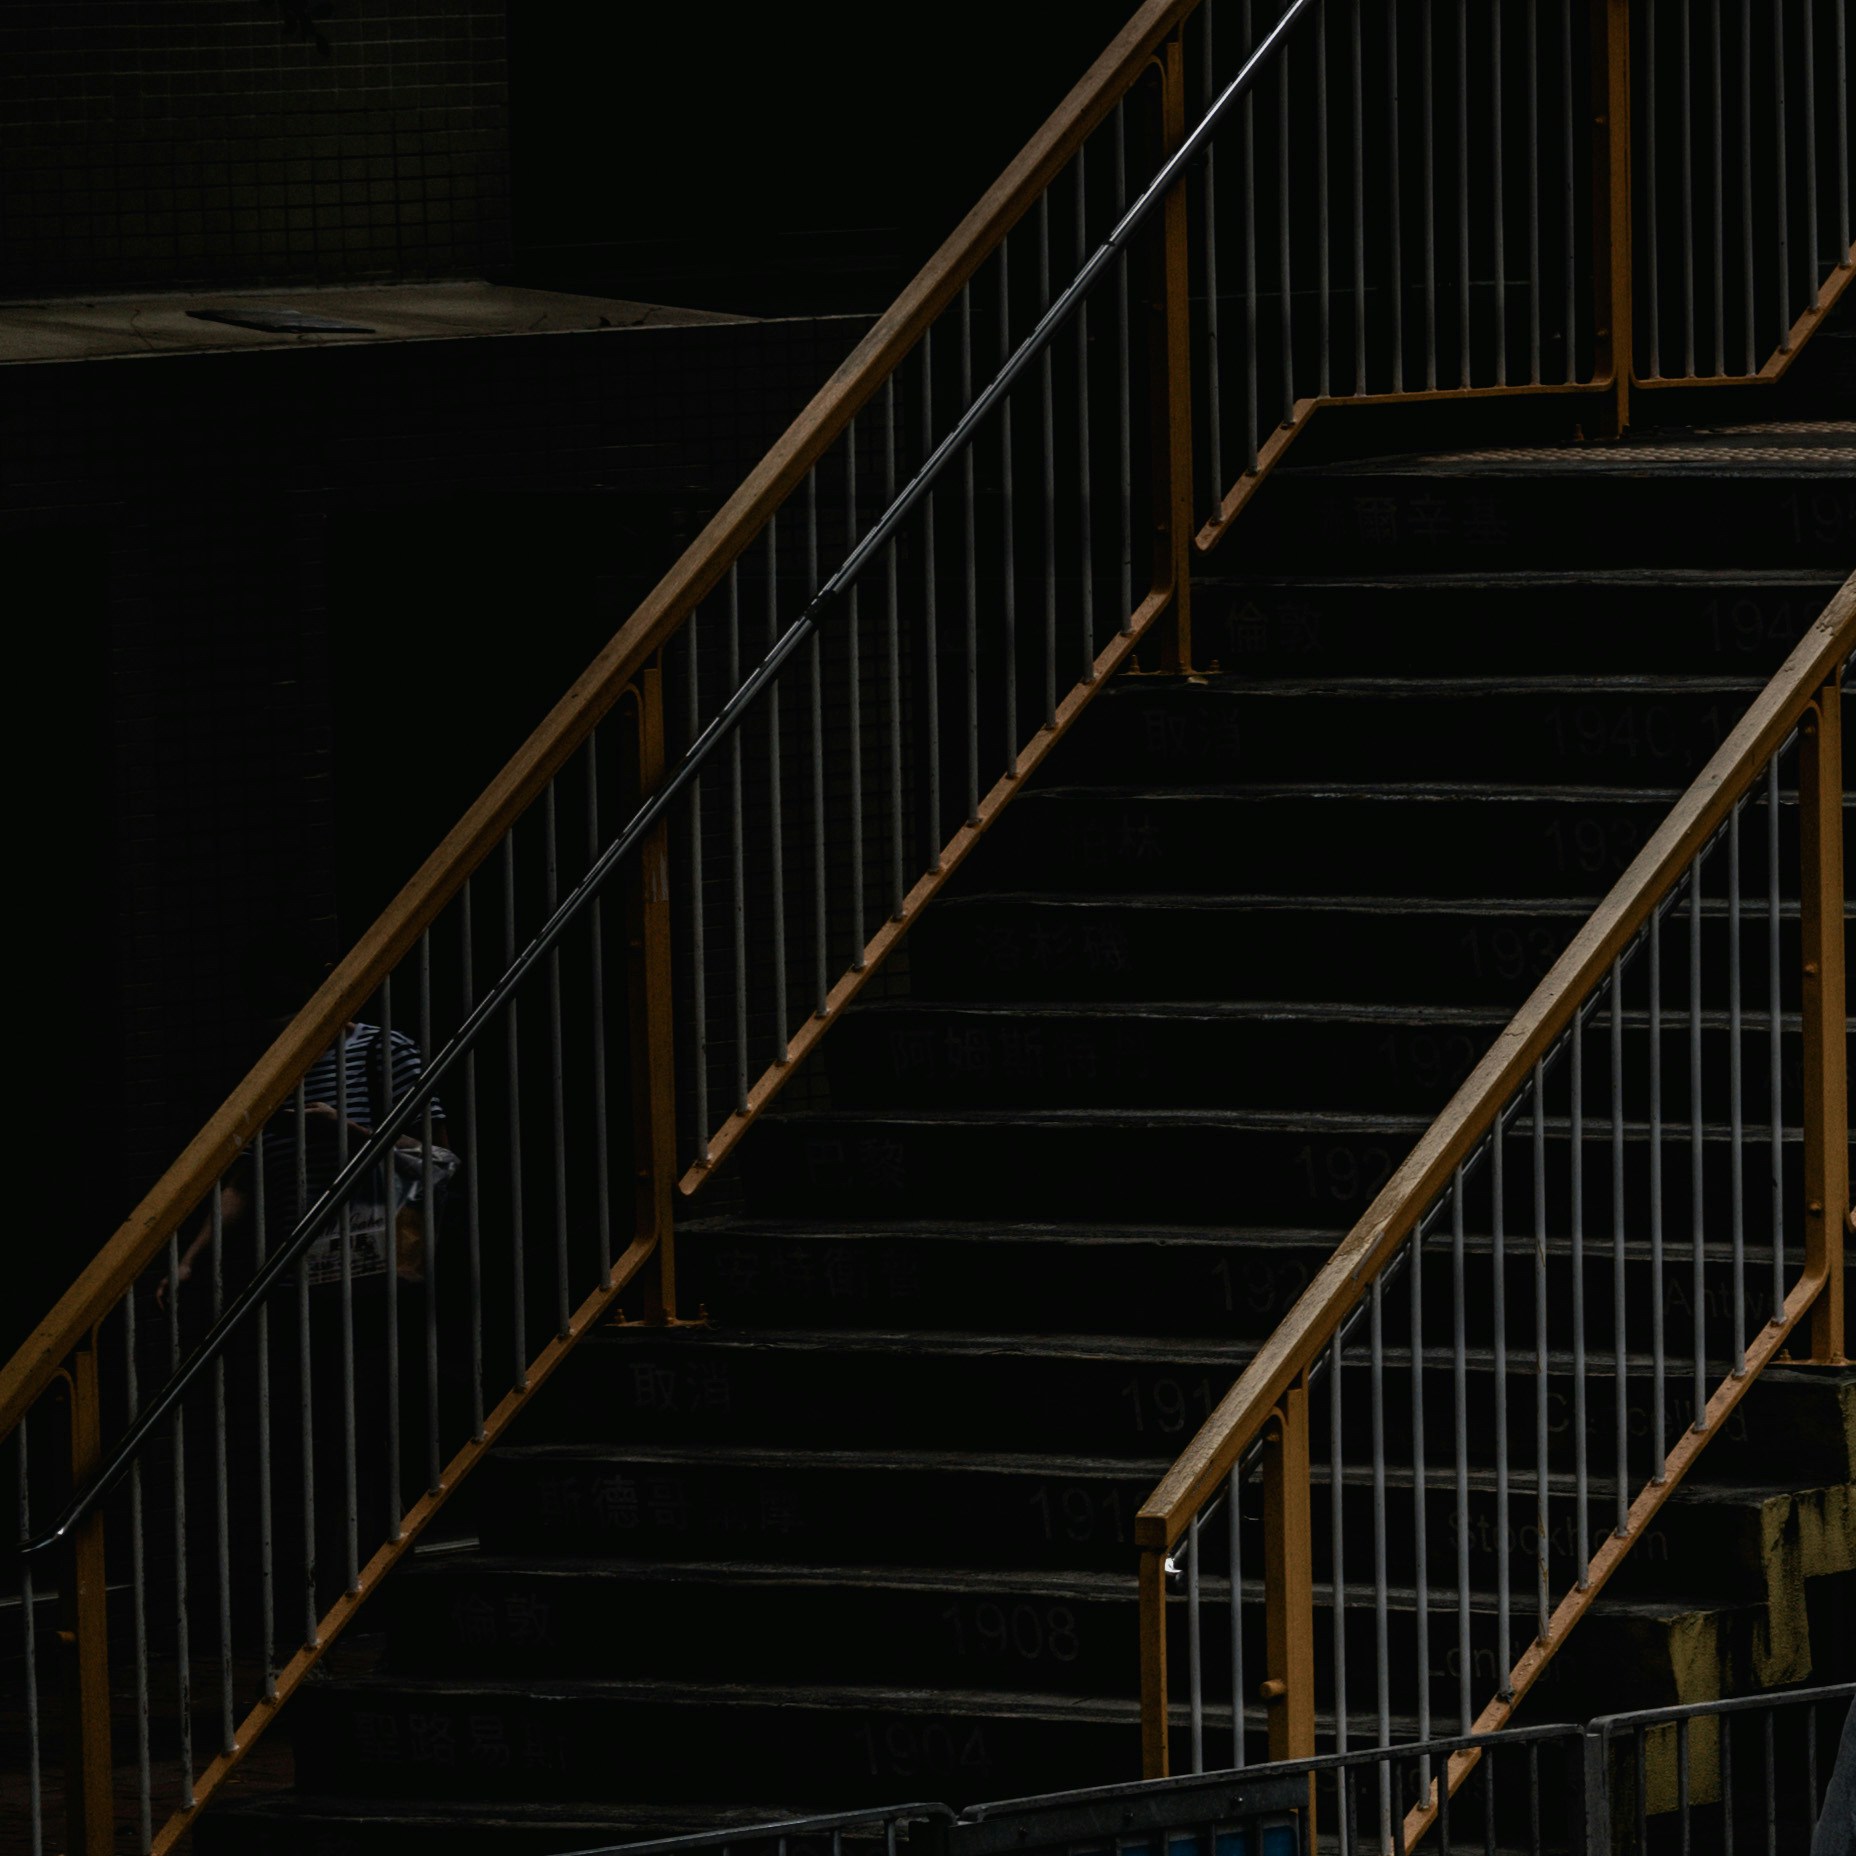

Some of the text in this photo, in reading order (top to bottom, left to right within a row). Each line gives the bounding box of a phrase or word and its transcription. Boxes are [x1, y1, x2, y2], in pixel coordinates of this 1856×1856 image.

[1225, 601, 1325, 654] 倫敦
[1142, 706, 1242, 759] 取消
[805, 1137, 907, 1190] 巴黎
[629, 1362, 732, 1412] 取消
[450, 1592, 557, 1647] 倫敦
[941, 1605, 1082, 1663] 1908
[854, 1721, 997, 1778] 1904
